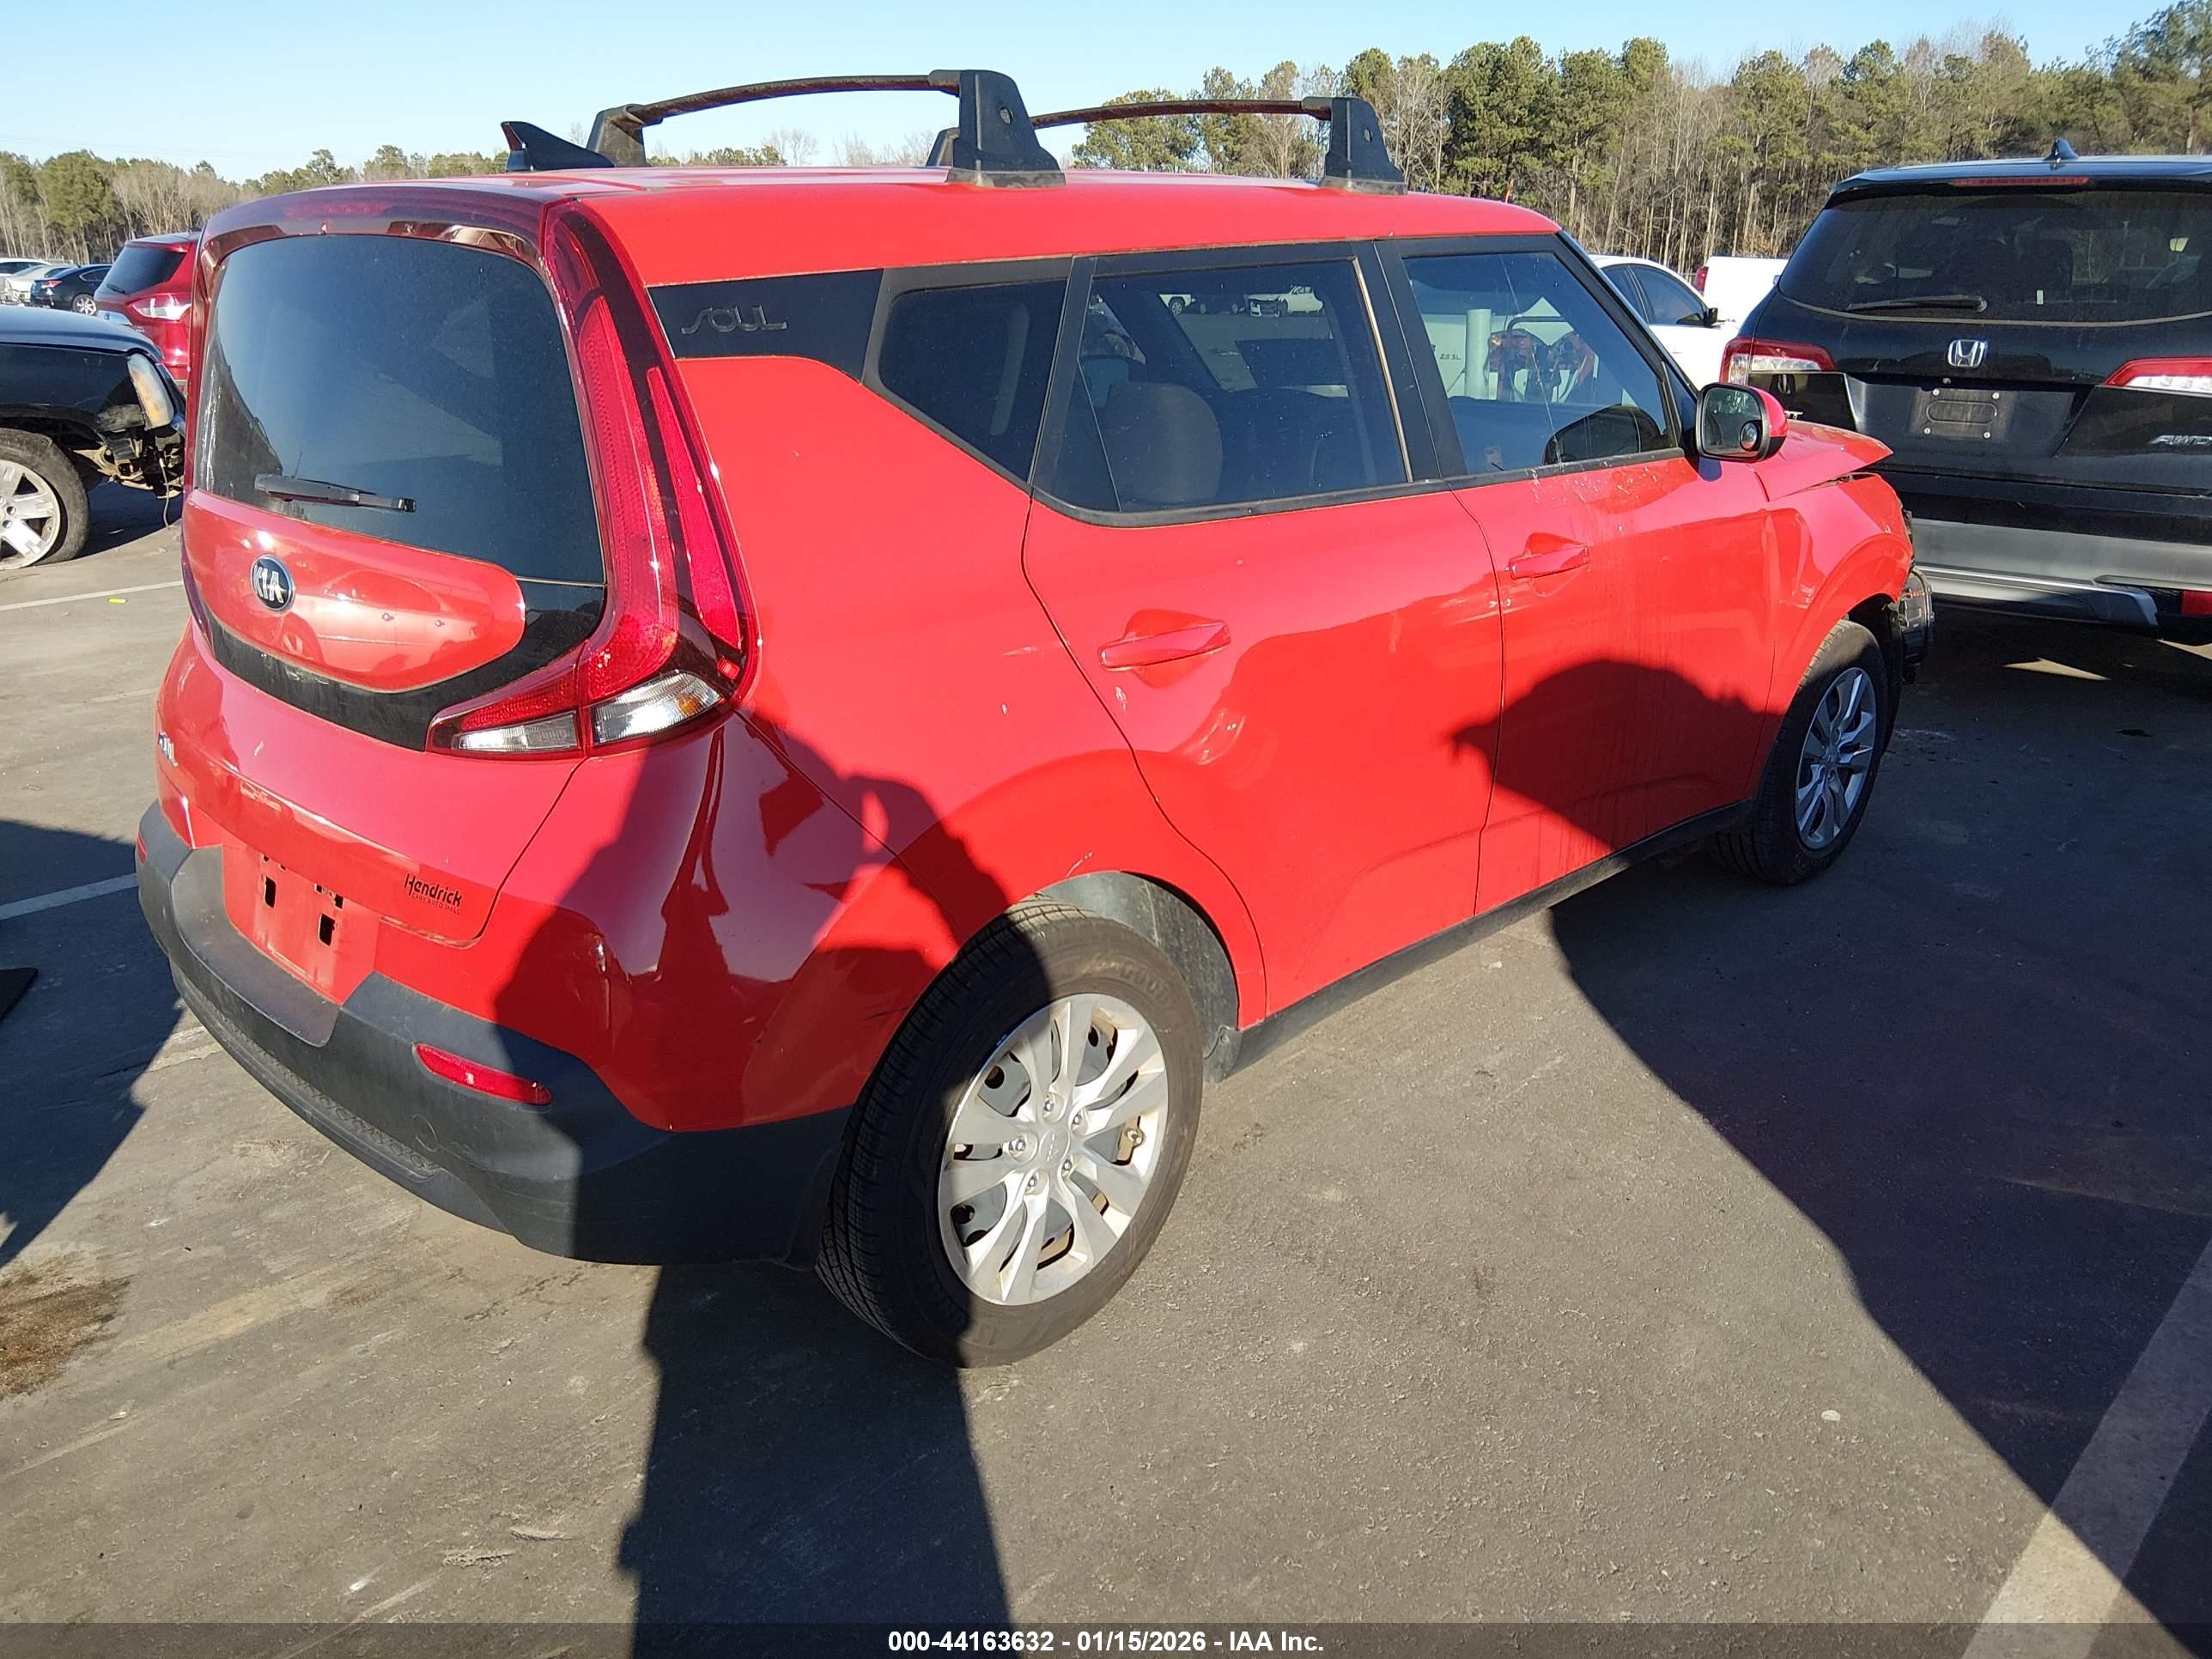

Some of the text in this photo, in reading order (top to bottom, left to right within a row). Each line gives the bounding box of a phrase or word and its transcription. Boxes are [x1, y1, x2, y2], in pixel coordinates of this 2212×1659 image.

[681, 304, 787, 334] SOUL
[253, 563, 284, 604] KIA
[404, 872, 463, 908] Hendrick
